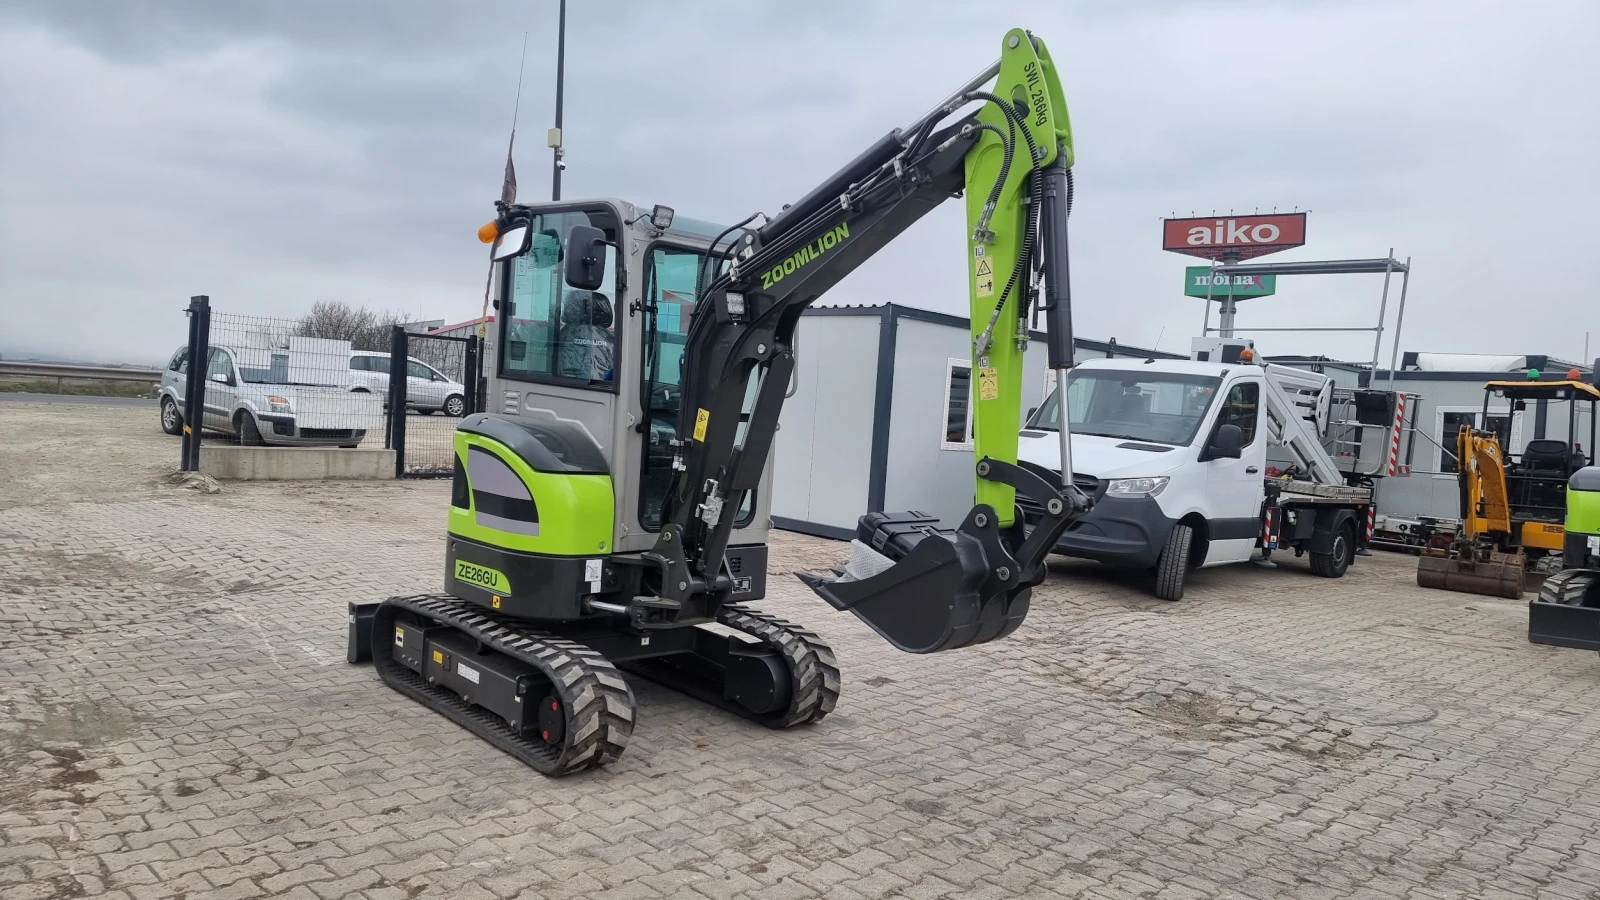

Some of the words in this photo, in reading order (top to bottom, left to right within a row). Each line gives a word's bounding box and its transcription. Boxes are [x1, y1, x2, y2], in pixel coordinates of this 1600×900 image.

[1024, 61, 1039, 91] SWL
[1031, 89, 1048, 127] 286kg
[1186, 219, 1280, 245] aiko
[760, 221, 850, 290] ZOOMLION
[458, 563, 498, 586] ZE26GU
